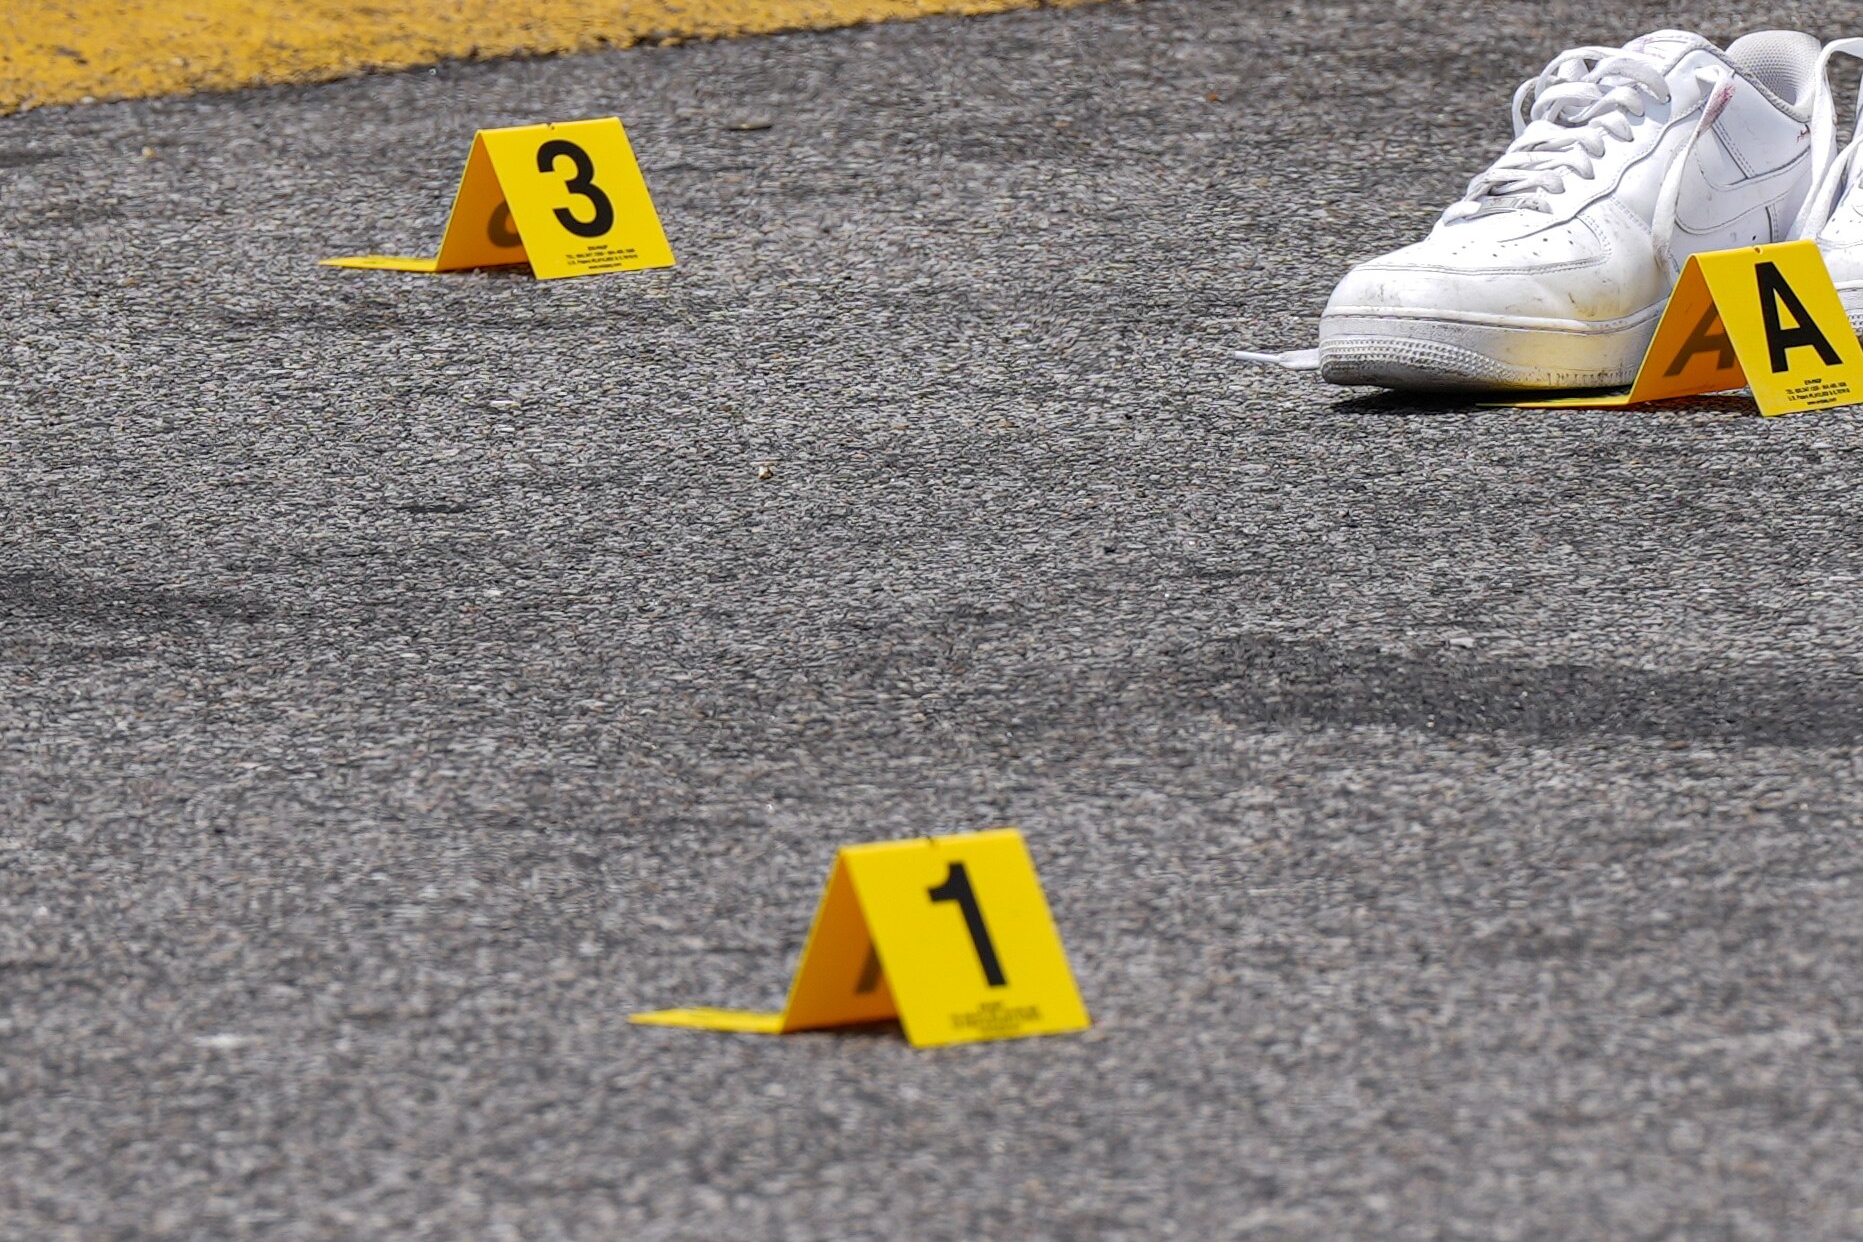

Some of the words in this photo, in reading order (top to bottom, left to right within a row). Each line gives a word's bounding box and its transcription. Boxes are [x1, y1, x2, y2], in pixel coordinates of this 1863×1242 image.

[537, 139, 615, 238] 3
[1755, 261, 1843, 374] A
[927, 861, 1008, 988] 1
